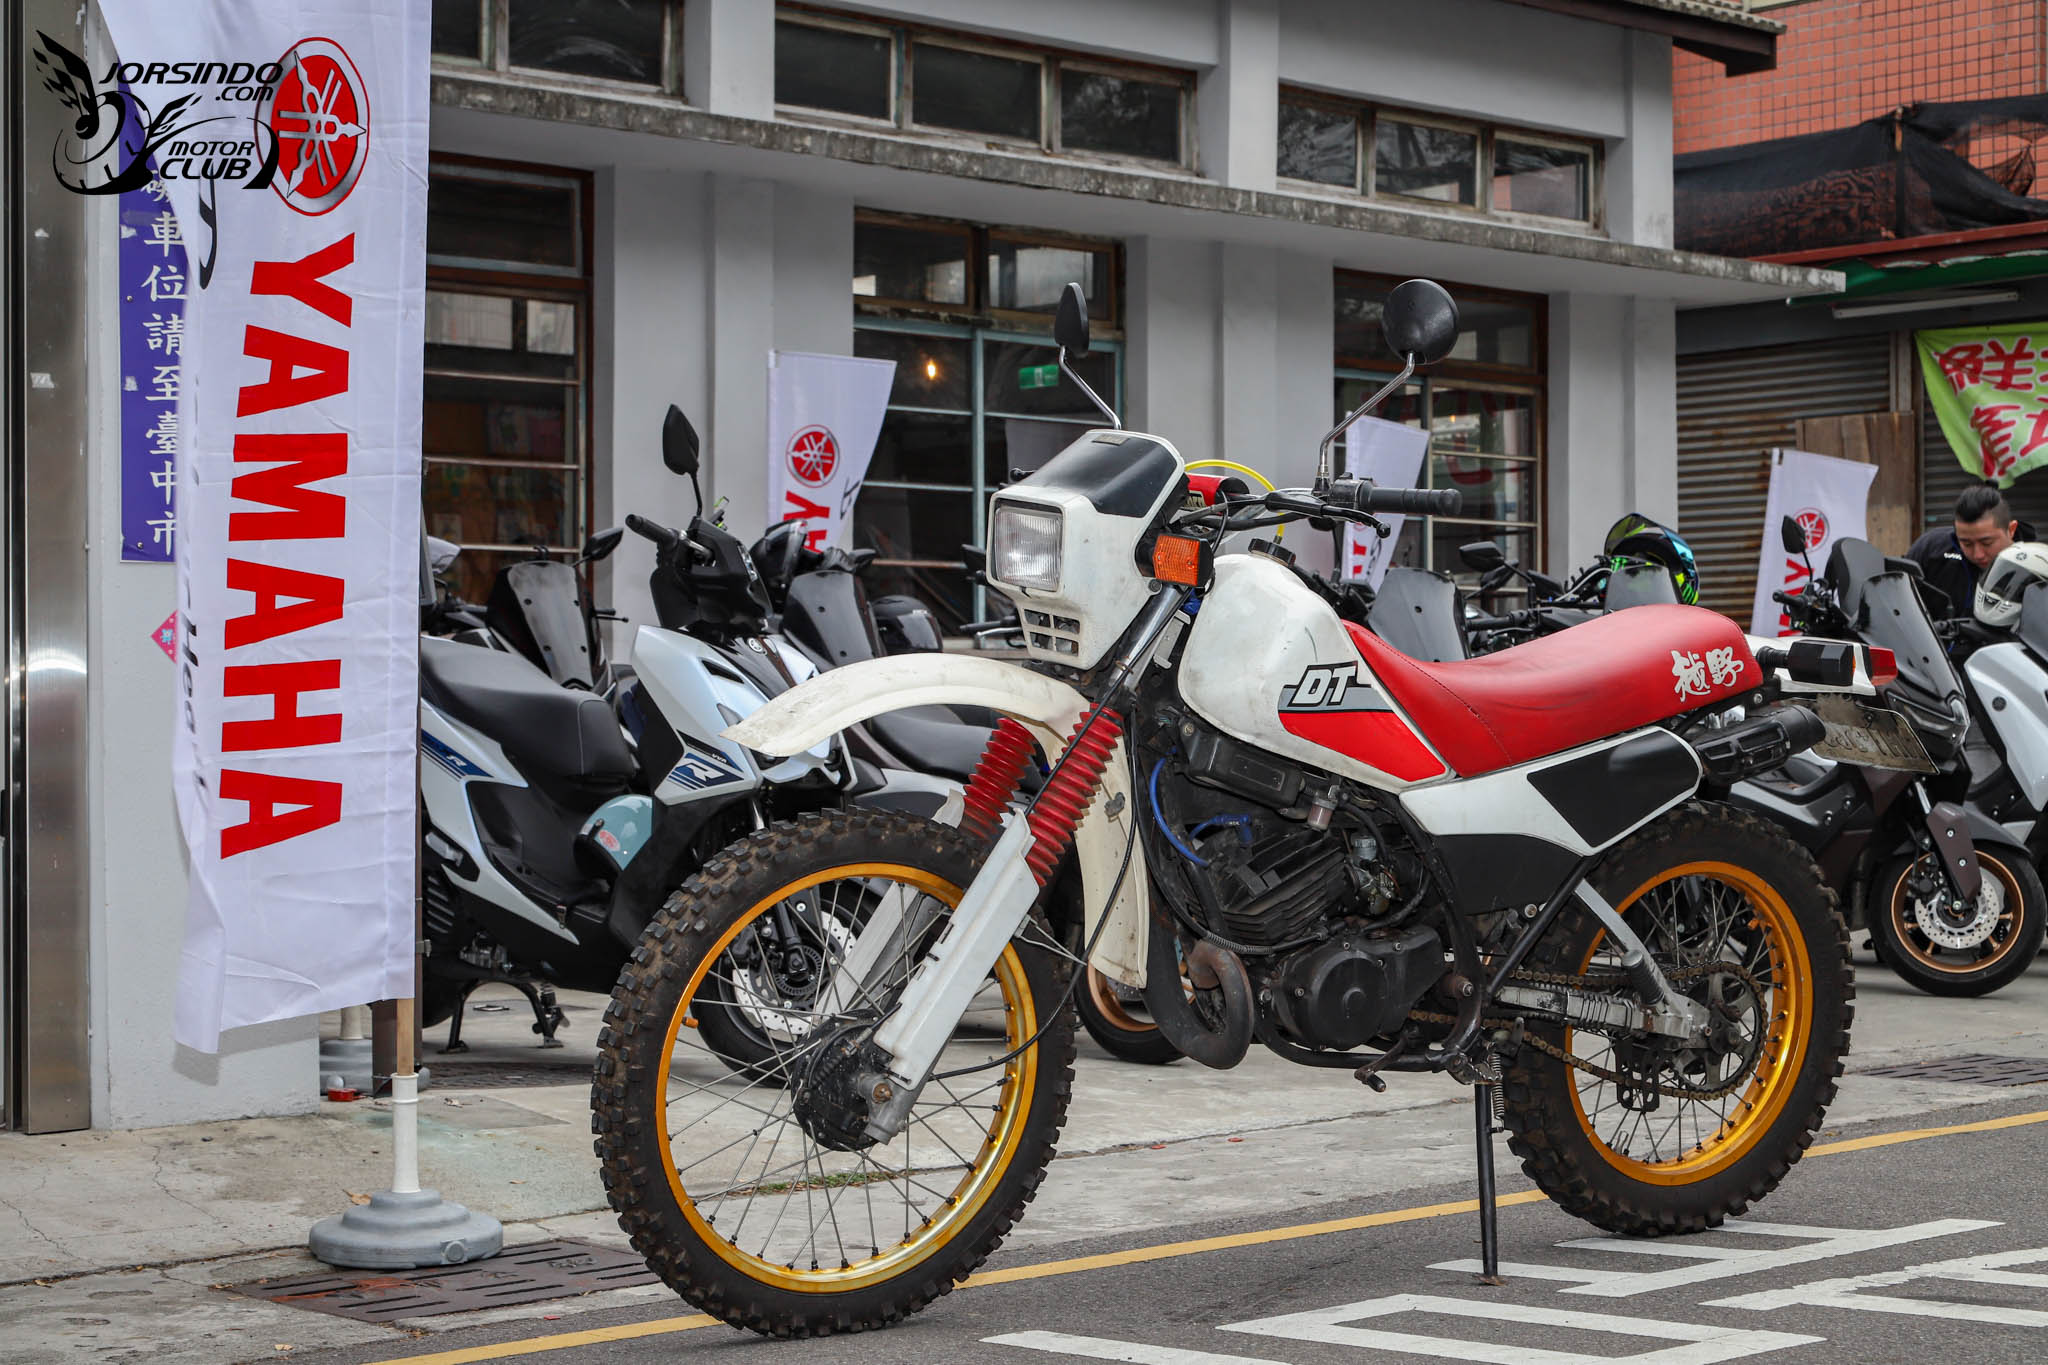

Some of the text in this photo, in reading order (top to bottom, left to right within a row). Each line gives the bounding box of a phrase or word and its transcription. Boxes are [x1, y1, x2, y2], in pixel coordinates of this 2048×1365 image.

[1933, 336, 2048, 408] 鮮
[219, 232, 355, 859] YAMAHA
[1289, 662, 1357, 706] DT
